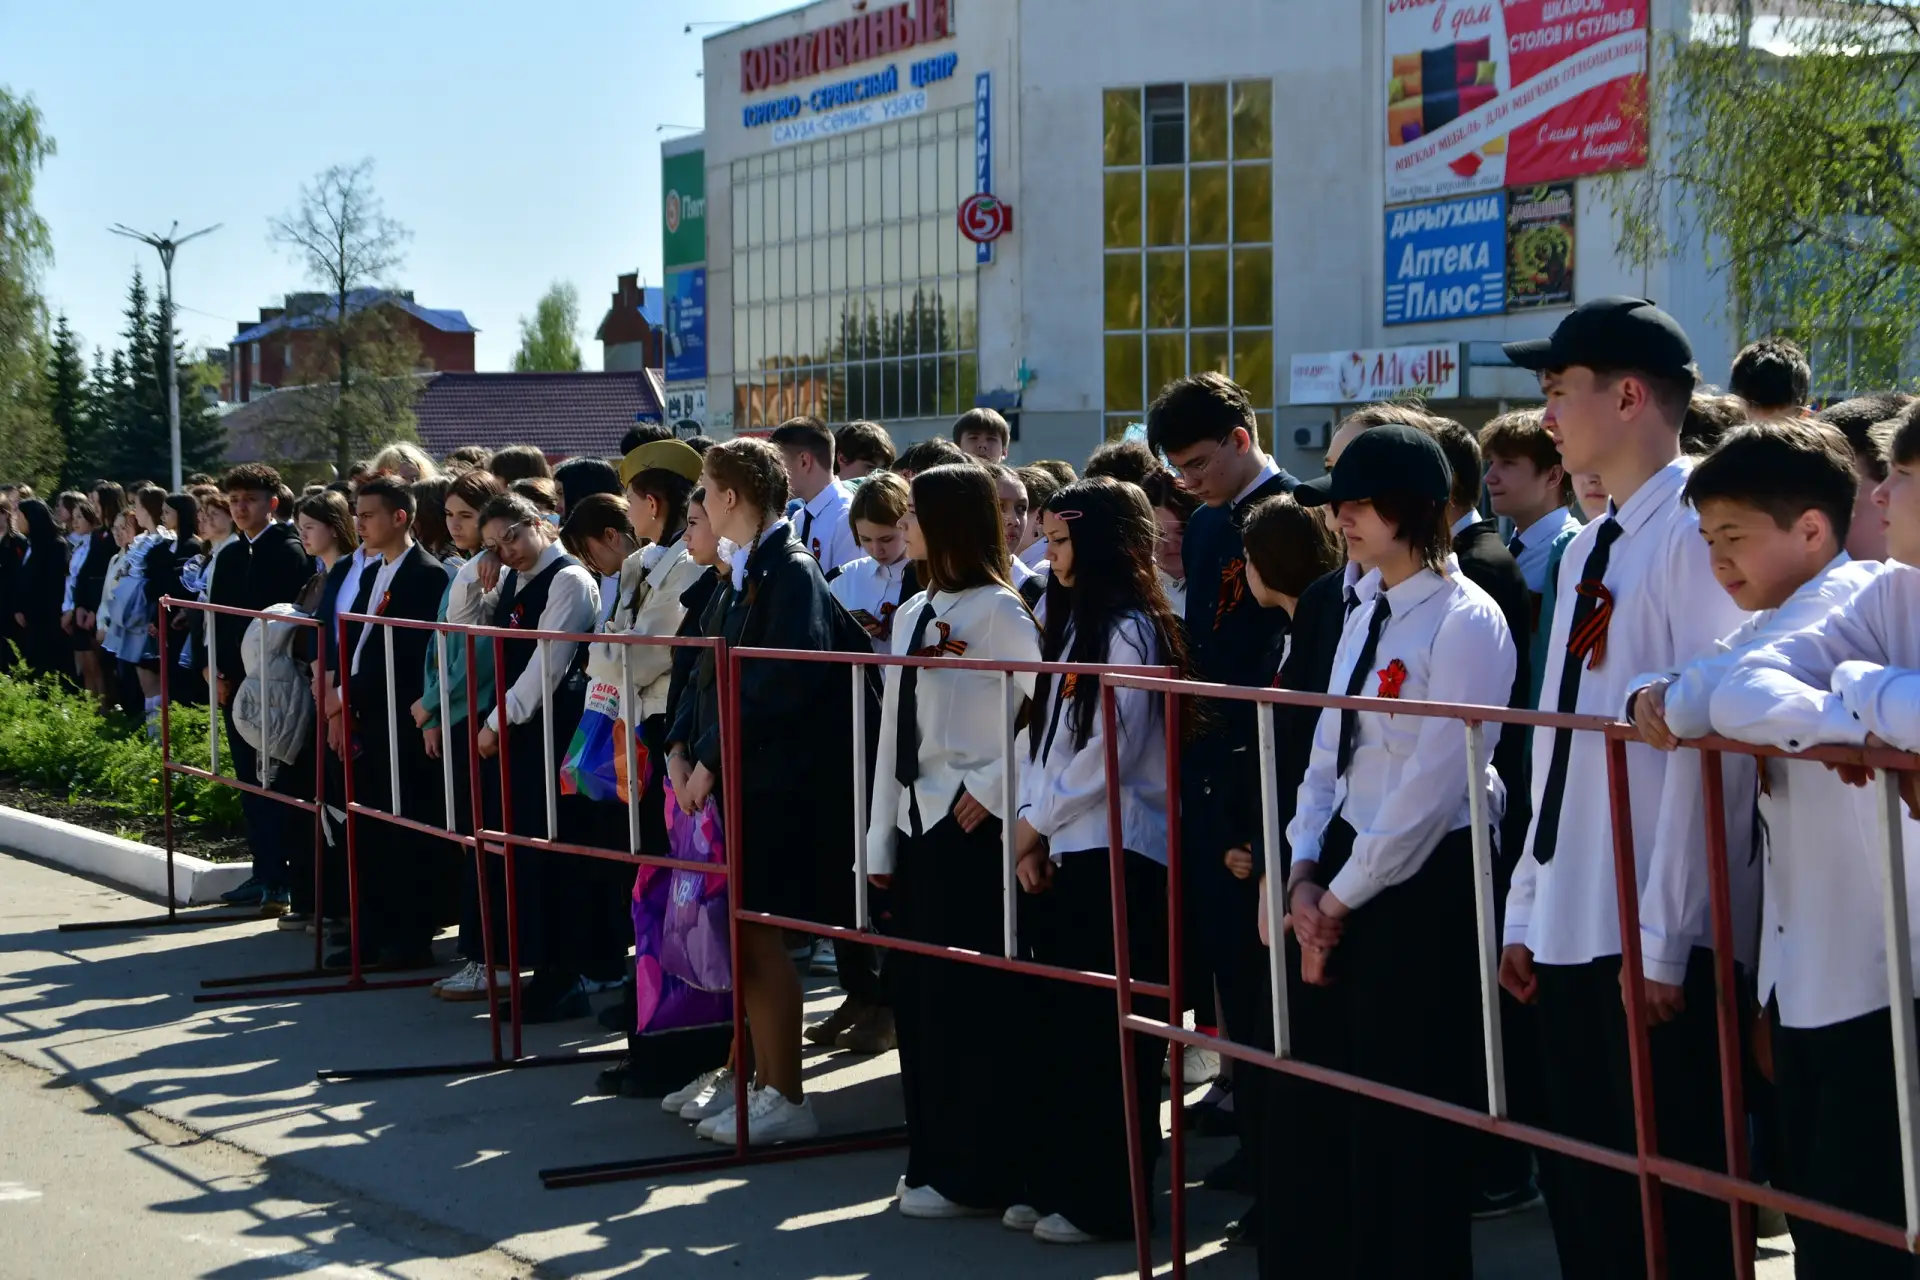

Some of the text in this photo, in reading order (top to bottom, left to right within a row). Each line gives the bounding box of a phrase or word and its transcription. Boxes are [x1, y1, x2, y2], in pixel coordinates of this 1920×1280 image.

[1451, 4, 1492, 38] дом
[1510, 8, 1636, 54] СТОЛОВ И СТУЛЬЕВ
[910, 52, 959, 88] ЦЕНТР
[1550, 127, 1579, 141] нами
[1583, 113, 1622, 140] удобно
[1390, 196, 1500, 239] ДАРЫУХАНА
